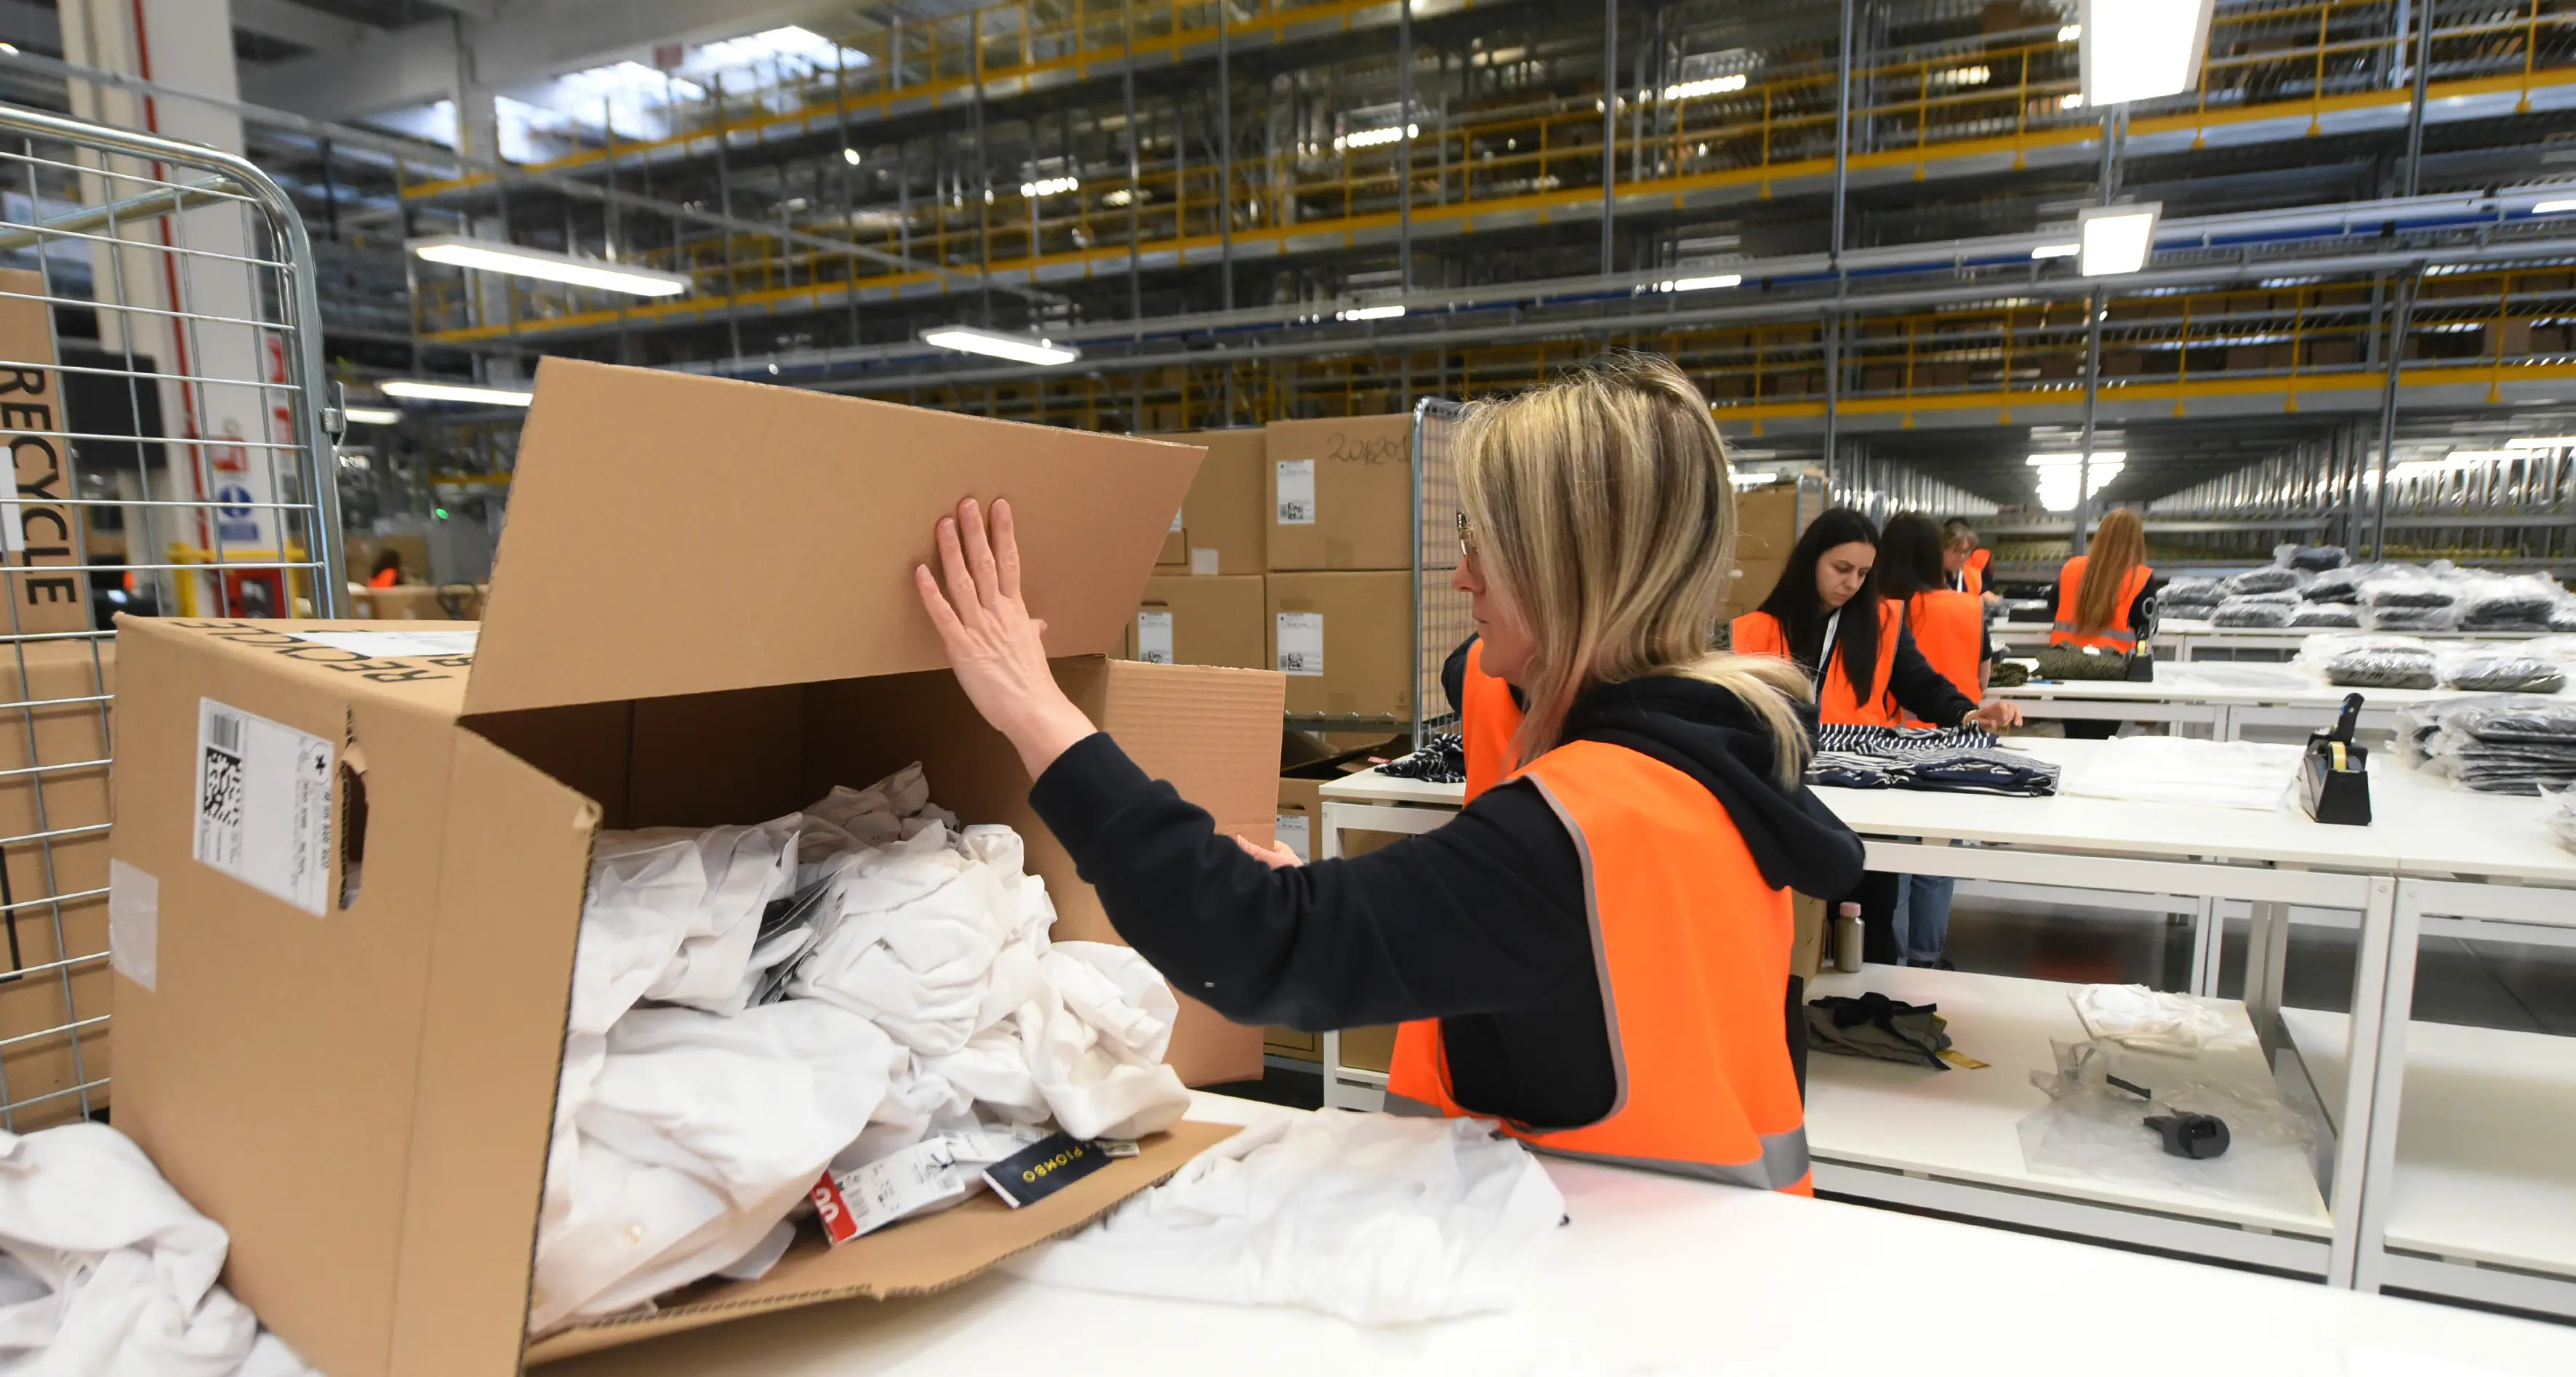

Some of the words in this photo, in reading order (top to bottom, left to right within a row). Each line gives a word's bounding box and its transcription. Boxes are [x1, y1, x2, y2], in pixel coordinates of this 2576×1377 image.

[0, 366, 77, 605] RECYCLE
[169, 622, 452, 683] RECYCLE
[1022, 1145, 1083, 1184] PIOMBO
